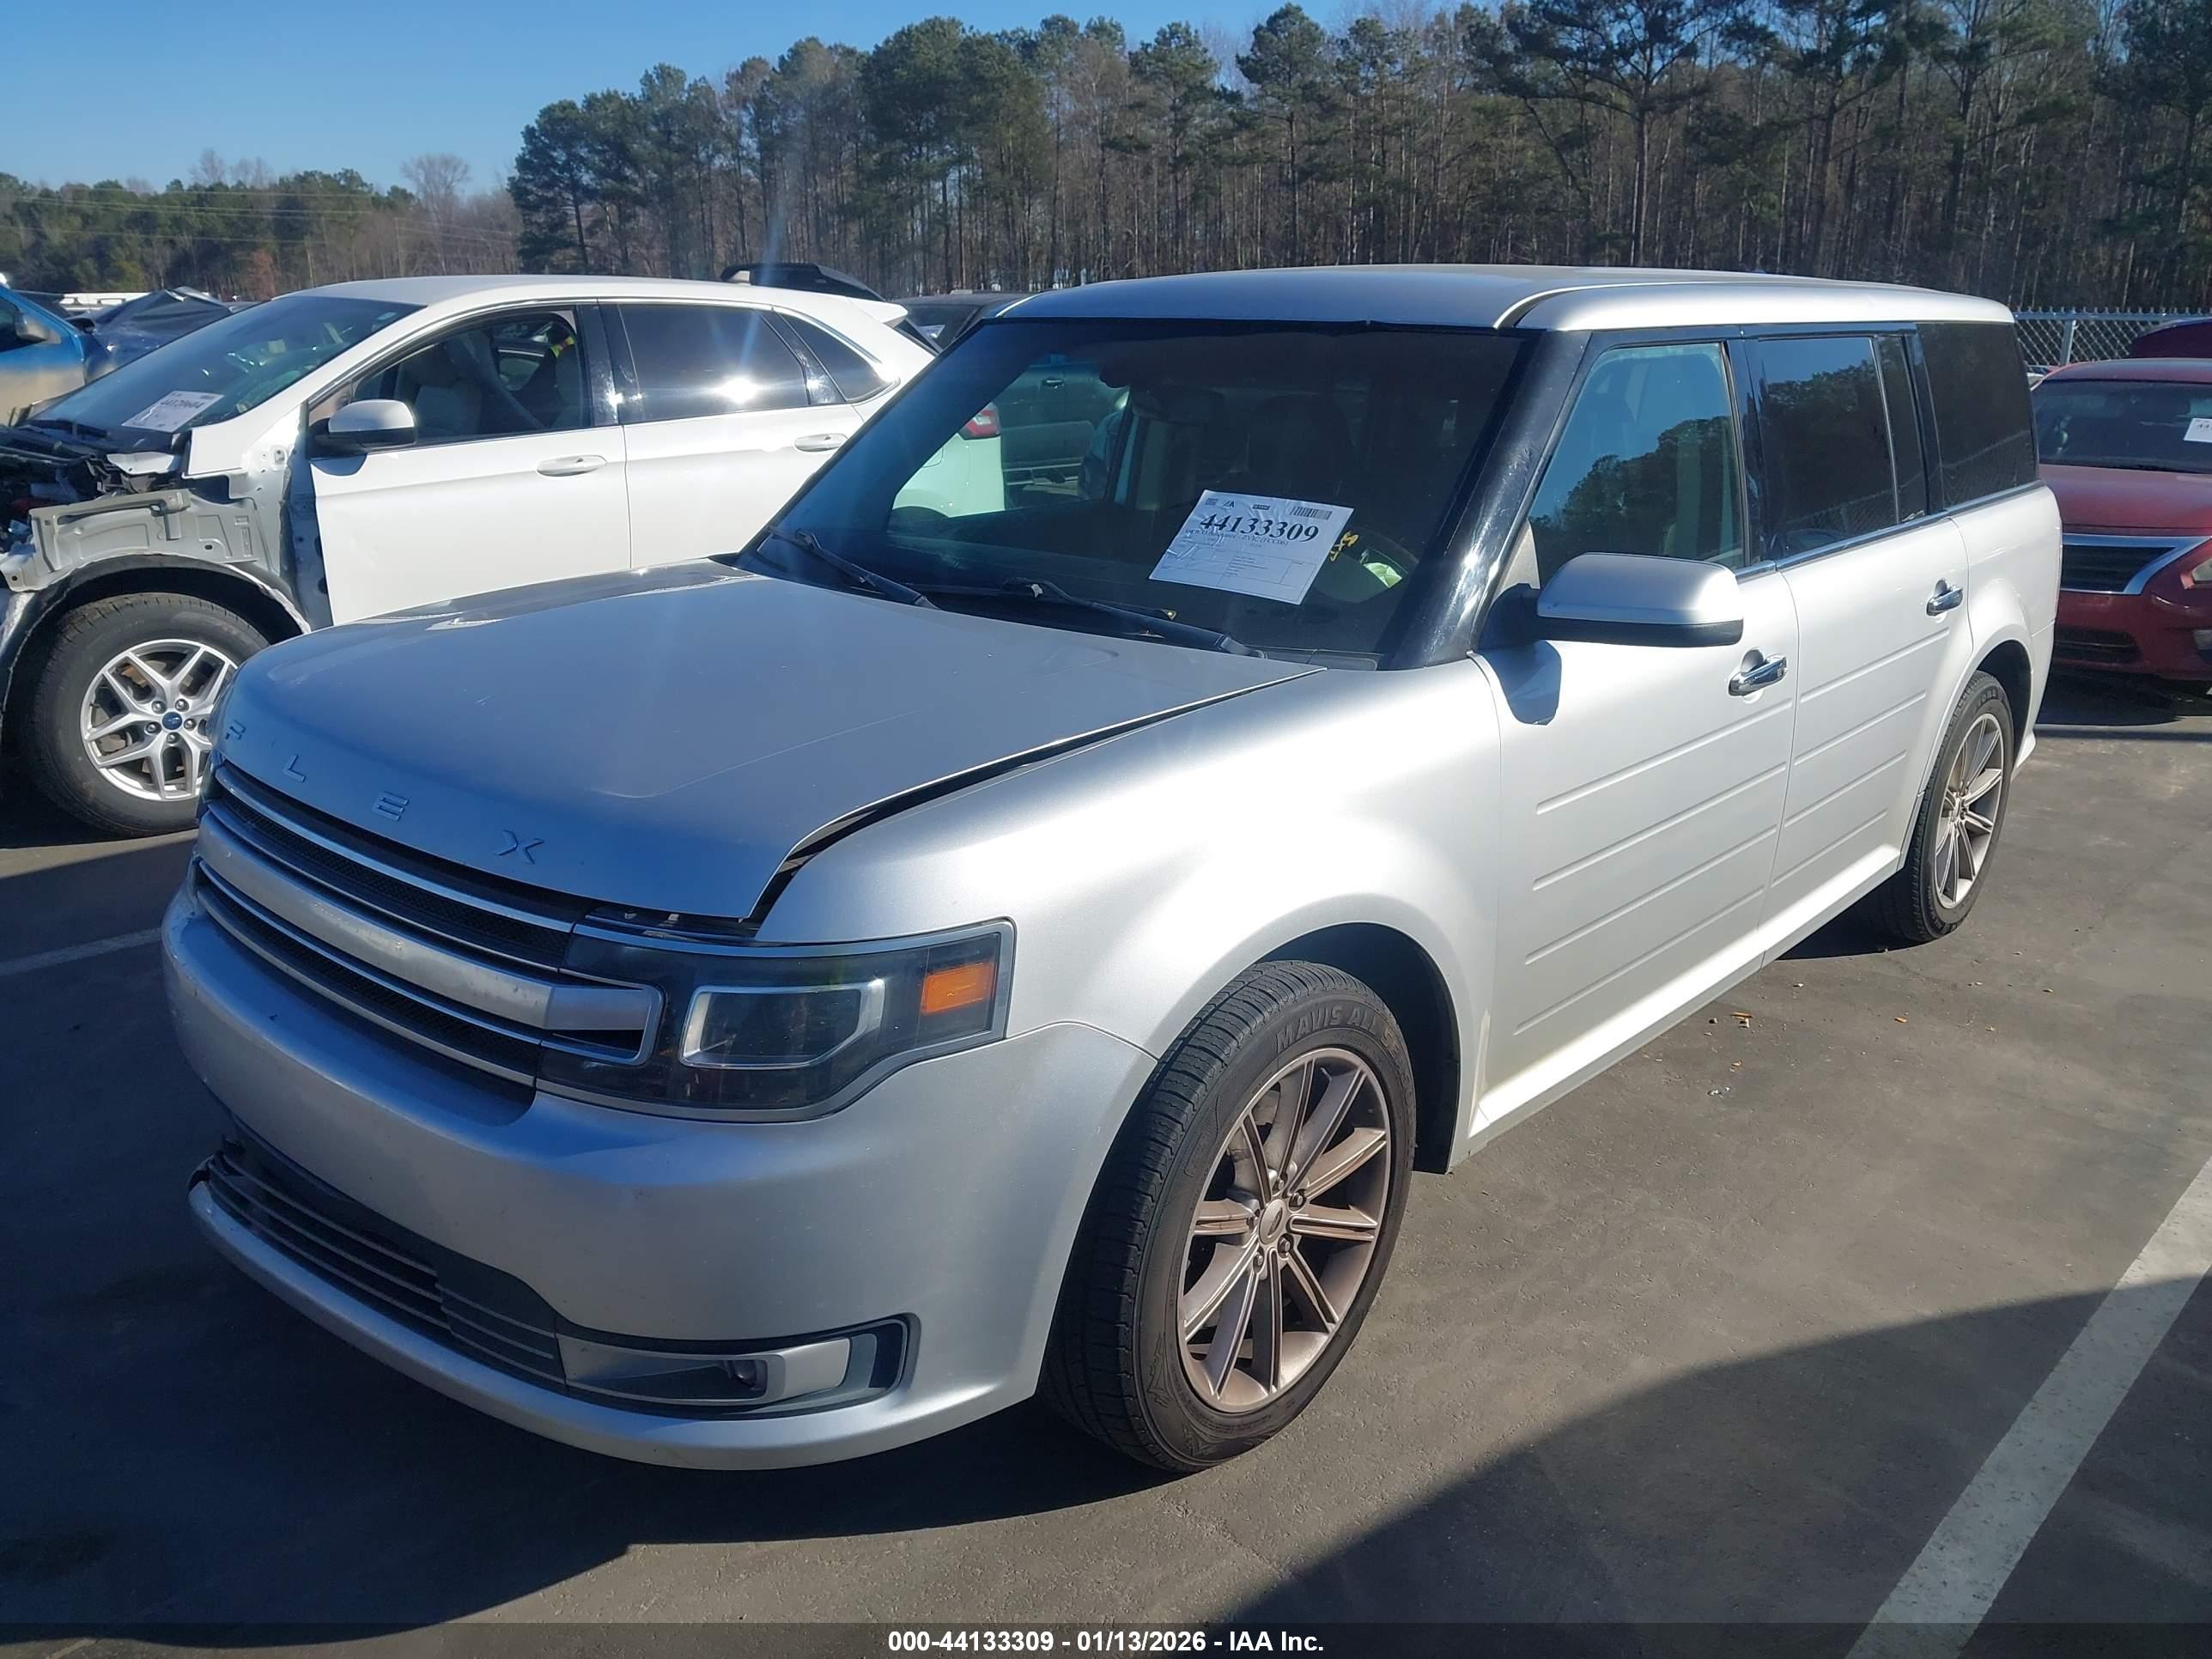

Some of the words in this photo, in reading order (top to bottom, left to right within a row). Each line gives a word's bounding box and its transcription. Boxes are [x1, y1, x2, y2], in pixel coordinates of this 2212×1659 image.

[1200, 514, 1320, 543] 44133309
[1275, 1005, 1344, 1054] MAVIS
[1346, 1007, 1377, 1036] ALL
